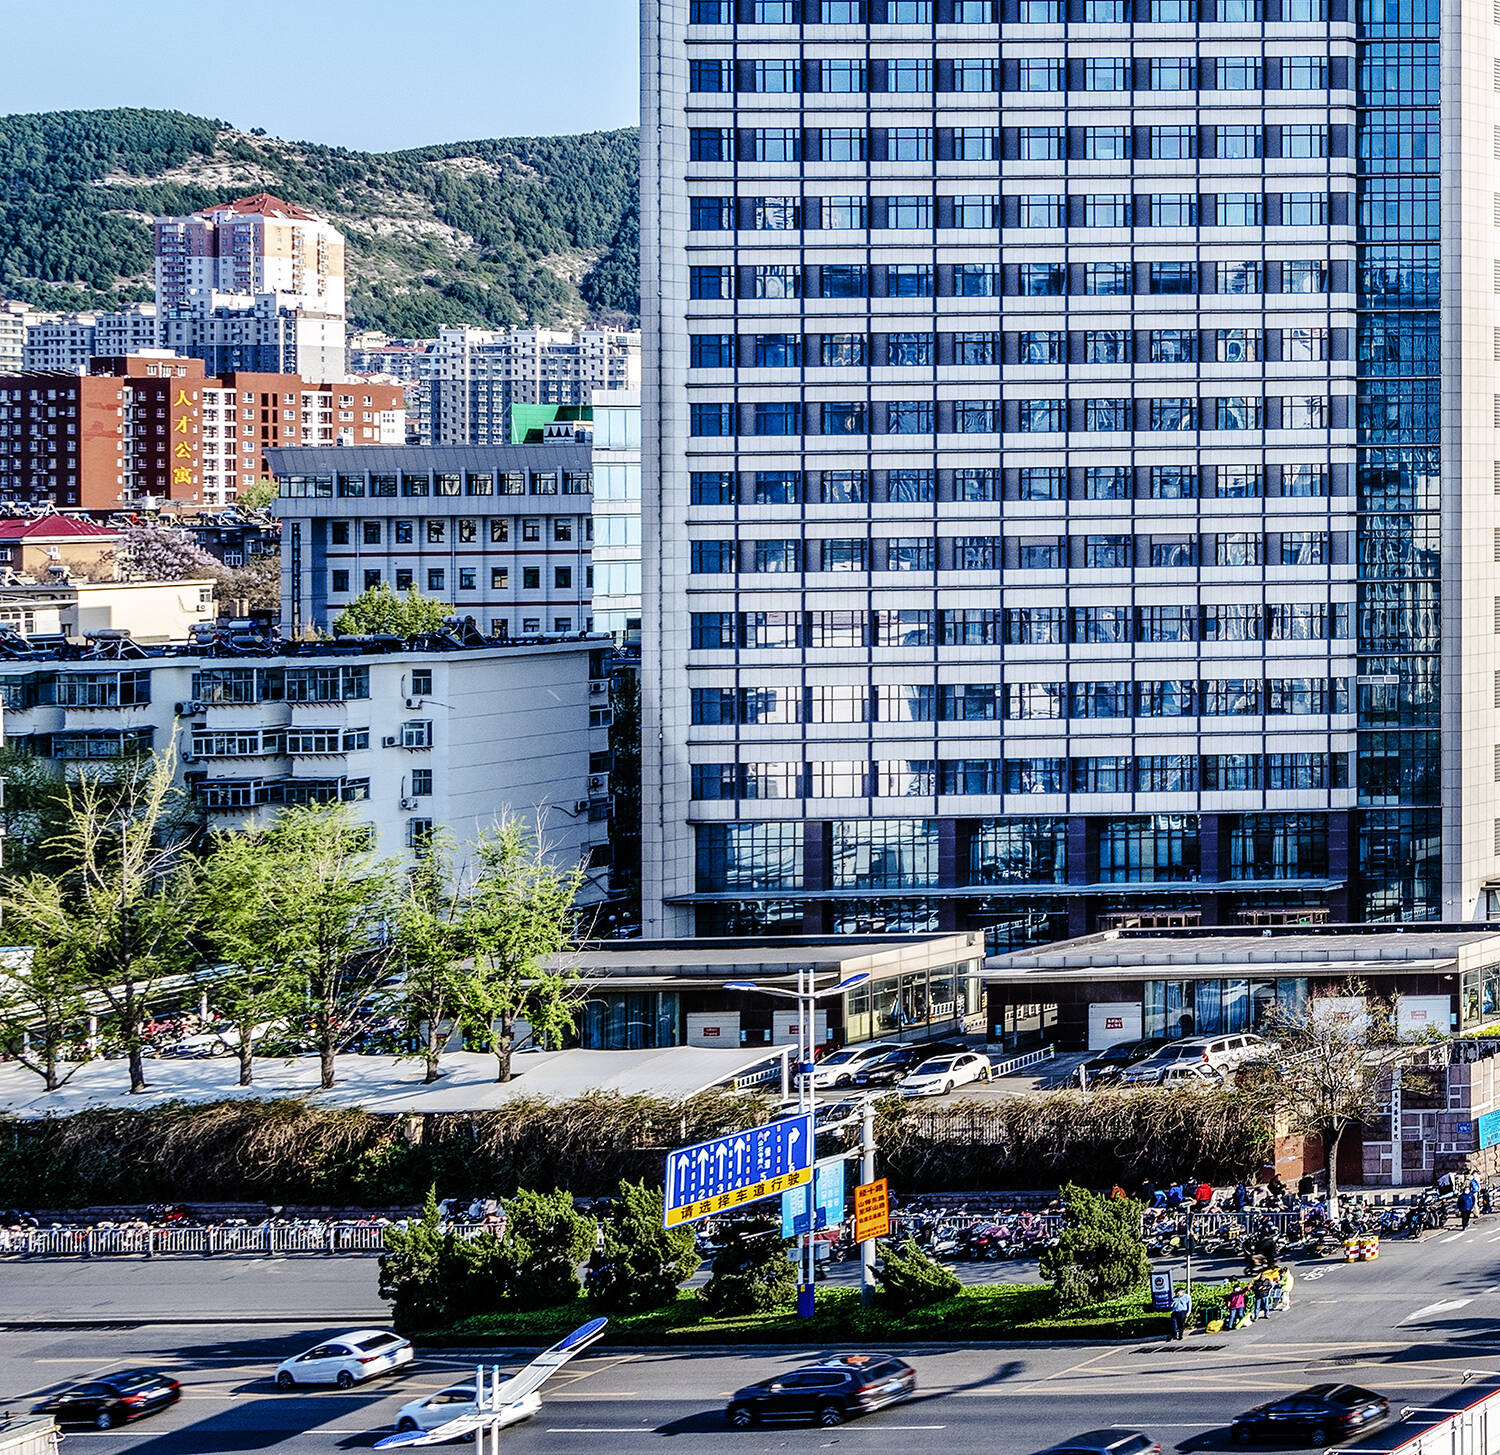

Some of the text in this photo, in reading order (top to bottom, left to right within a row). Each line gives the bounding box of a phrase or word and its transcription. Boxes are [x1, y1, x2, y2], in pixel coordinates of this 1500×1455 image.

[173, 389, 193, 485] 人才公寓
[788, 1162, 796, 1173] 6
[735, 1177, 742, 1189] 4
[760, 1171, 767, 1183] 5
[698, 1189, 706, 1201] 2
[717, 1184, 724, 1195] 3
[679, 1194, 685, 1206] 1
[681, 1172, 801, 1220] 请选择车道行驶
